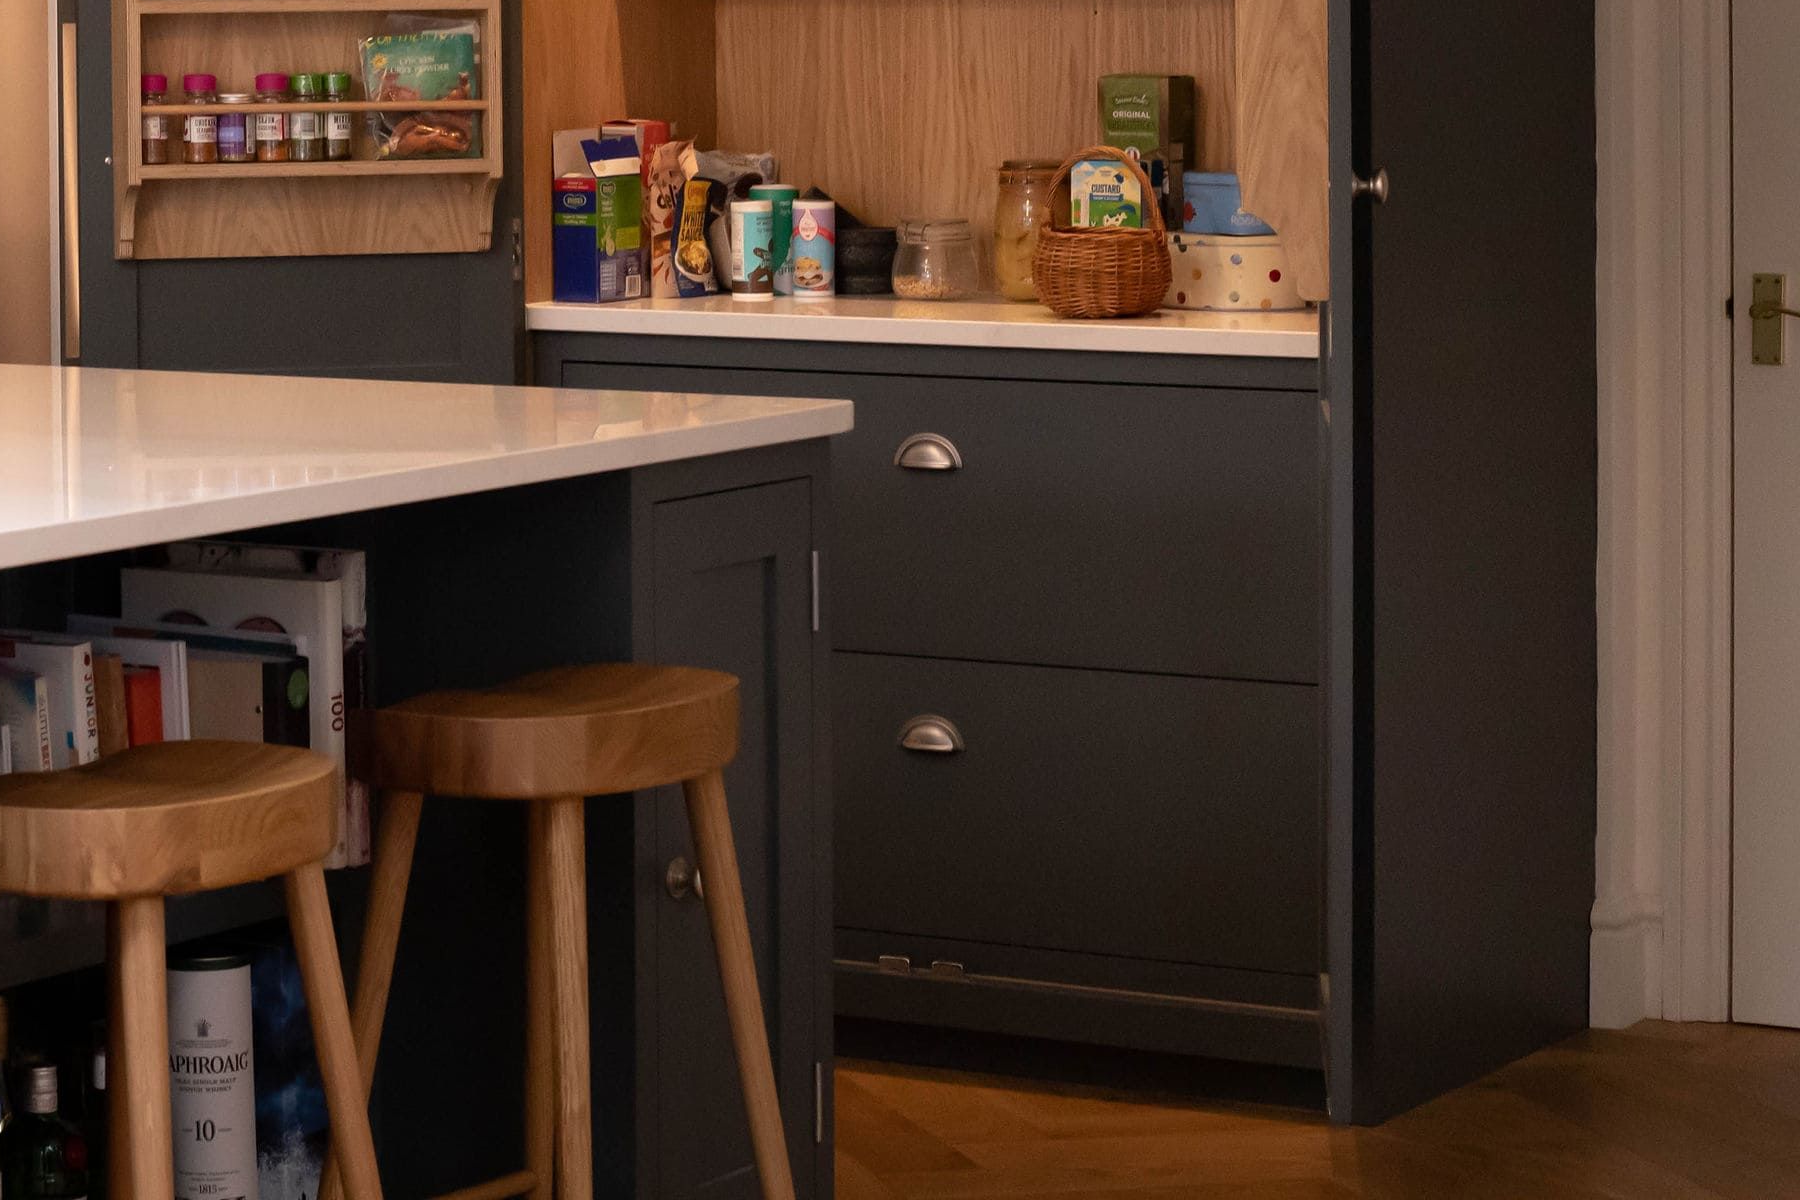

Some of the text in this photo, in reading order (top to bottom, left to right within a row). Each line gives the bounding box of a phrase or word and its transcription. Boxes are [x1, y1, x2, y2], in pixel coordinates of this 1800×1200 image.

[1112, 110, 1151, 120] ORIGINAL
[1091, 183, 1121, 195] CUSTARD
[83, 673, 99, 740] JUNIOR
[167, 1050, 249, 1075] APHROAIG
[194, 1119, 216, 1142] 10
